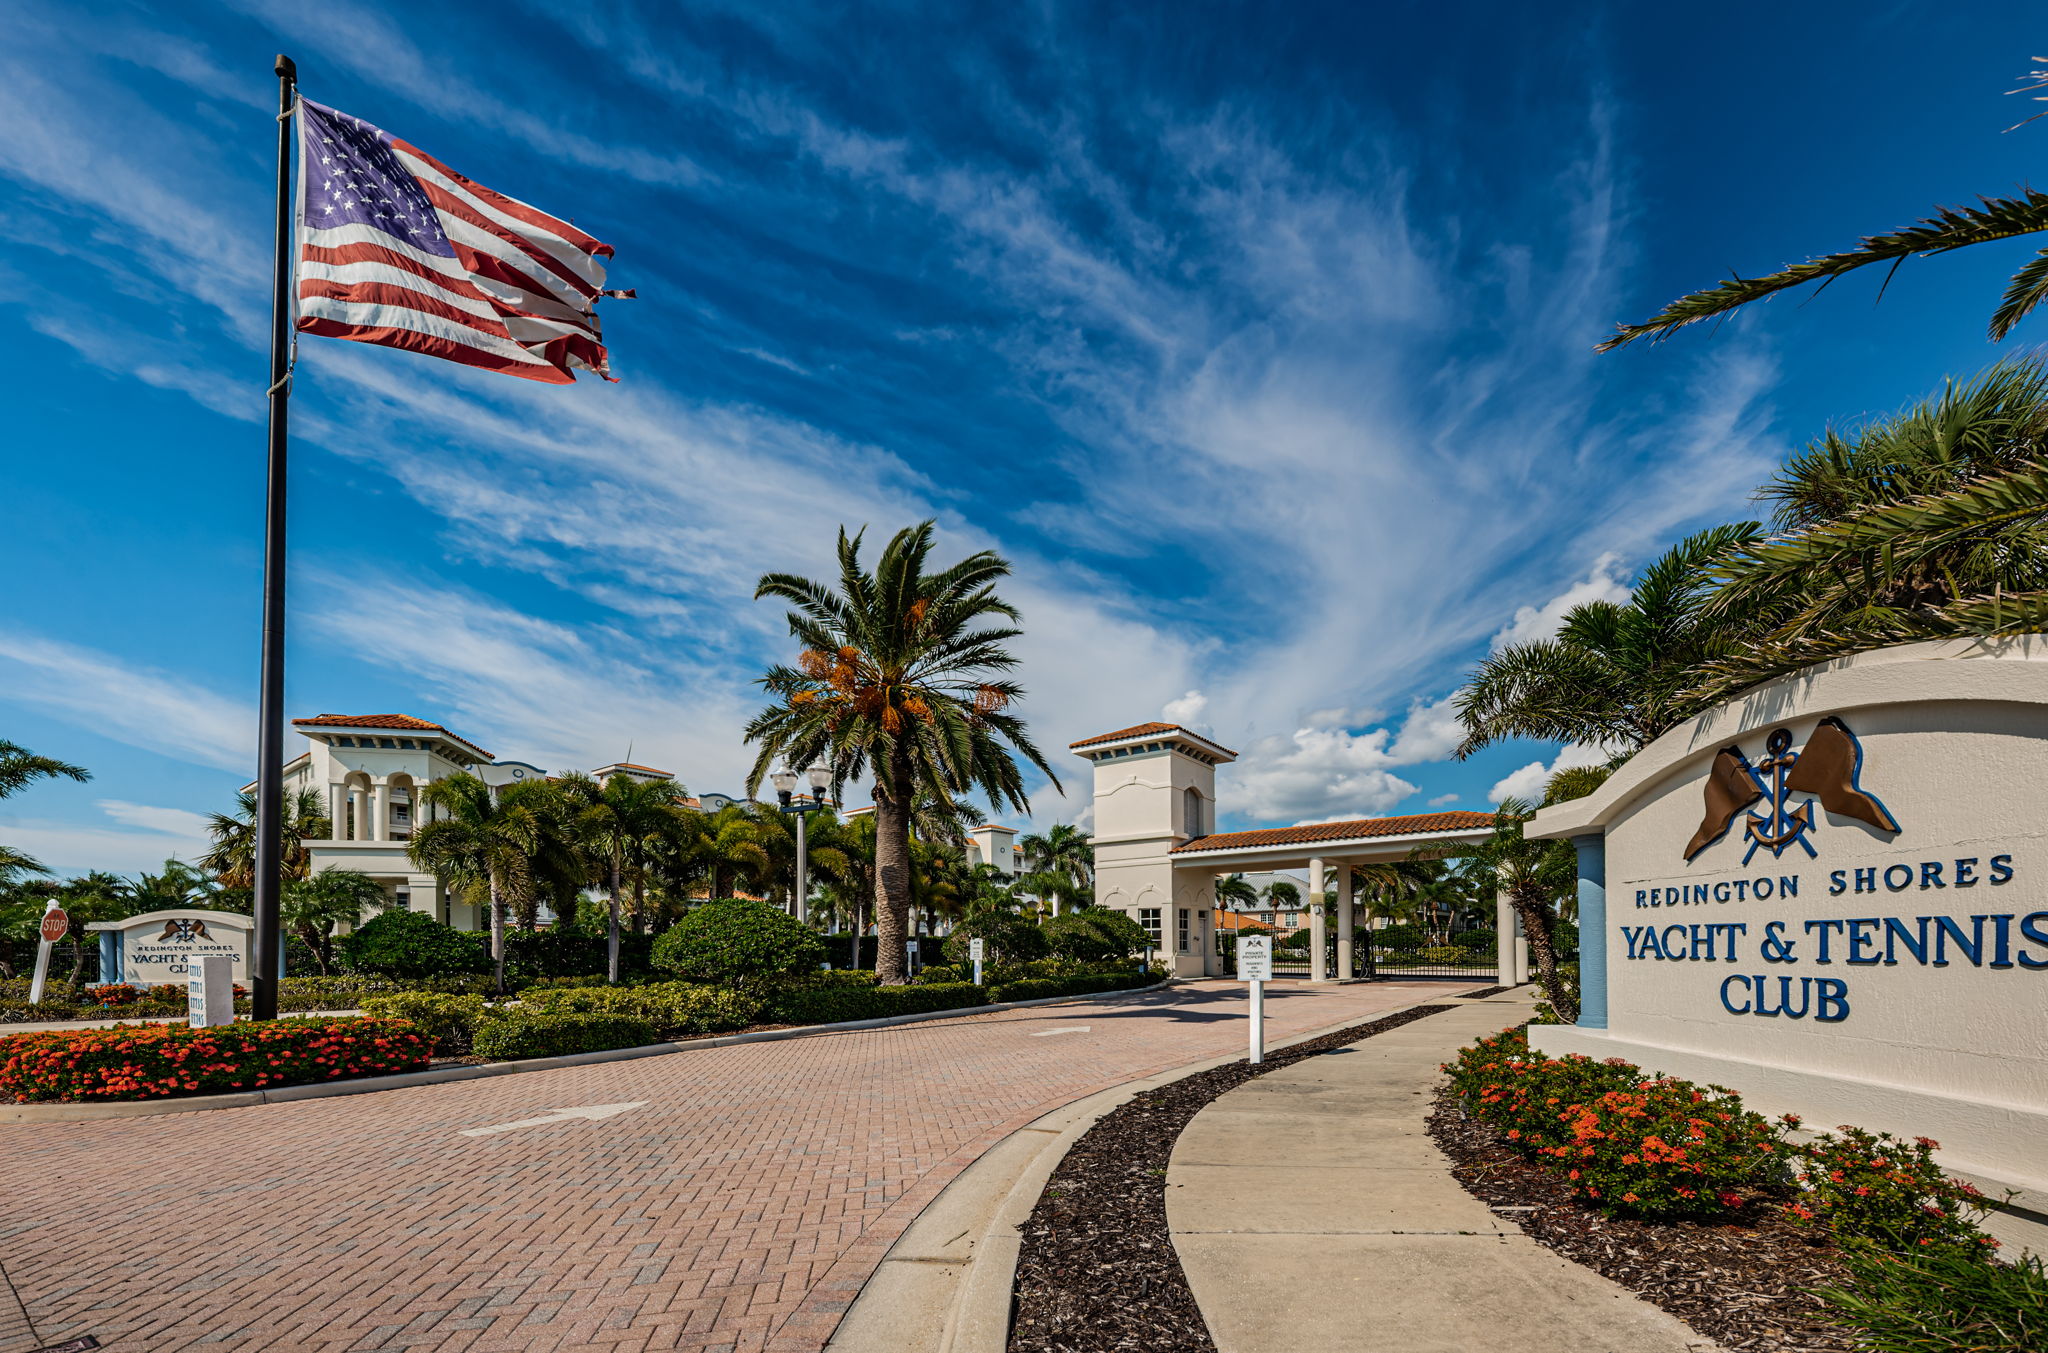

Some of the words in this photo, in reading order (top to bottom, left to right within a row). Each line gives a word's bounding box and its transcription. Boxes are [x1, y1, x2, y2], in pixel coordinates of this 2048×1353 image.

[1635, 875, 1799, 909] REDINGTON
[1828, 854, 2014, 896] SHORES
[43, 919, 66, 931] STOP
[1620, 922, 1747, 964] YACHT
[1760, 920, 1799, 964] &
[1804, 911, 2048, 971] TENNIS
[132, 954, 178, 963] YACHT
[180, 954, 188, 962] &
[169, 964, 188, 973] CL
[1720, 973, 1850, 1022] CLUB
